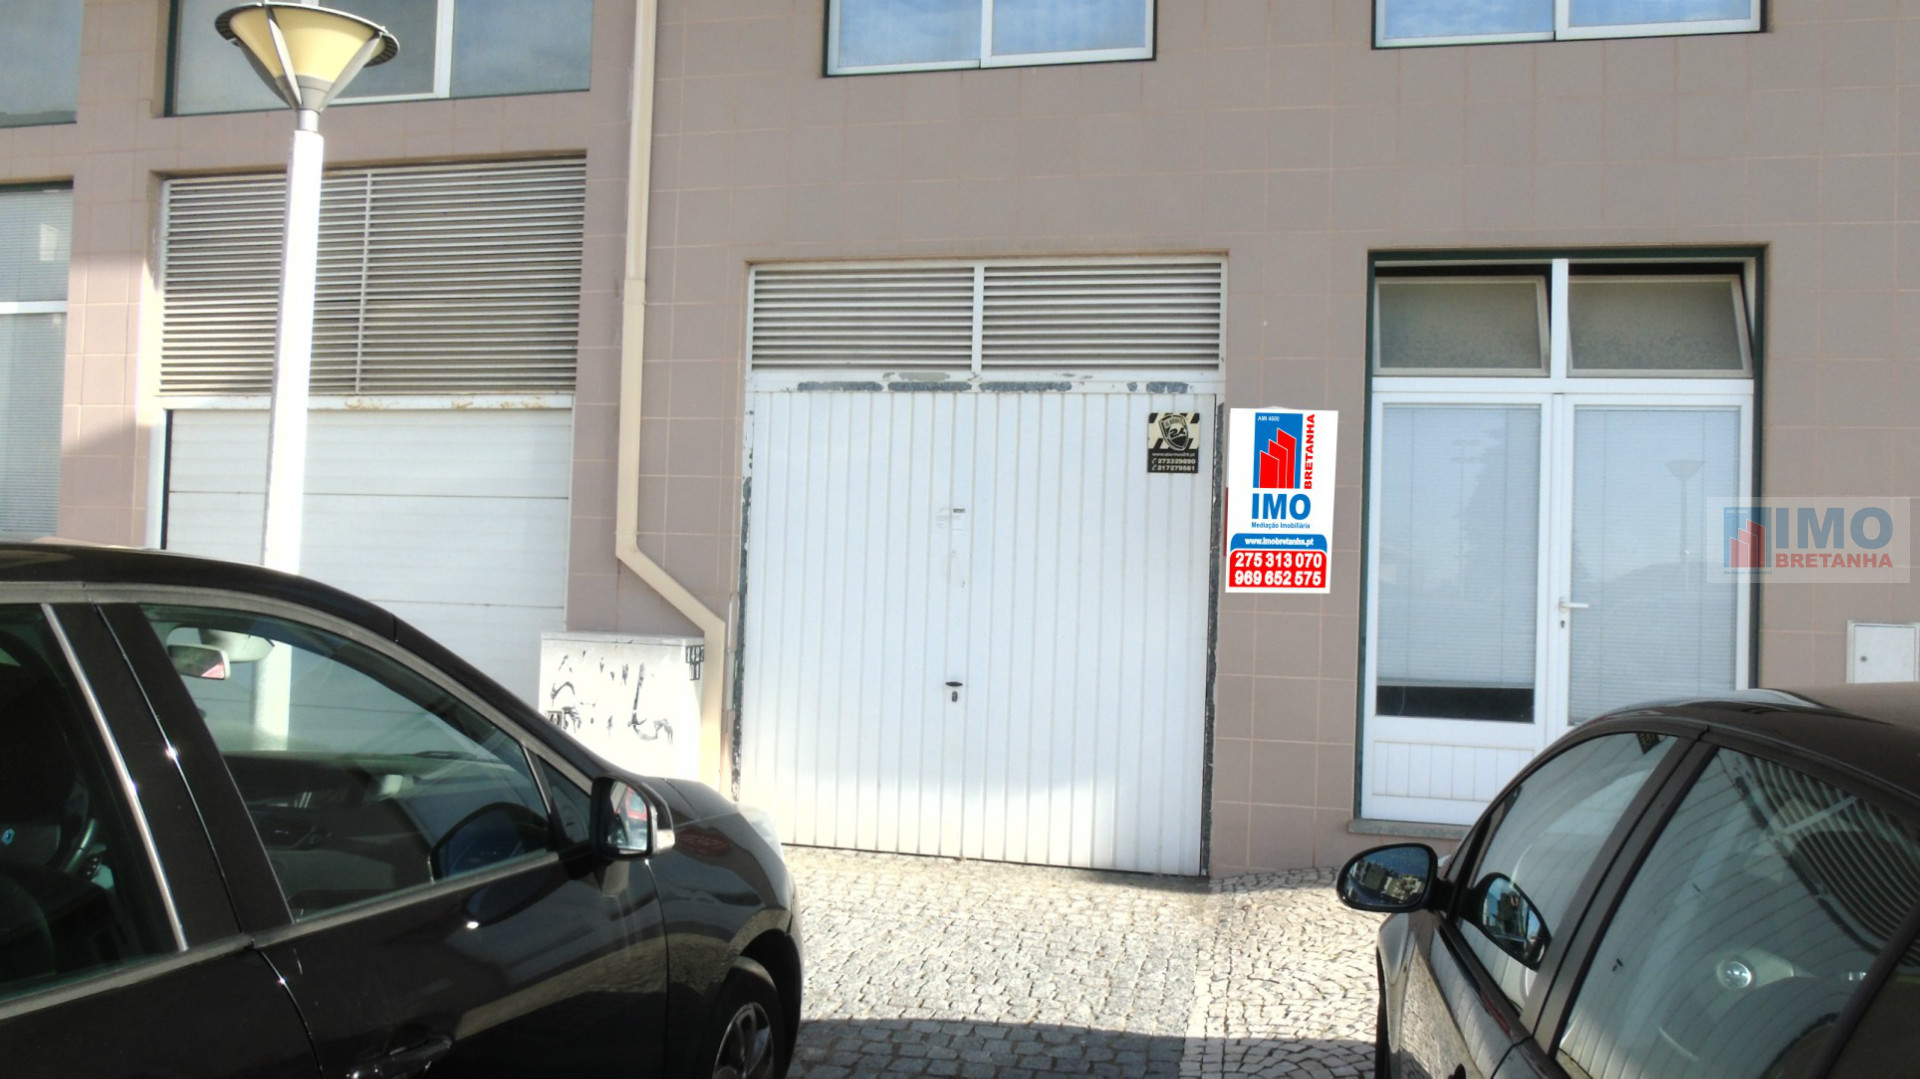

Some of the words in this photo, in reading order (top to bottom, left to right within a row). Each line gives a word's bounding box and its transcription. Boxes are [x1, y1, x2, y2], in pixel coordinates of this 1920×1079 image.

[1304, 414, 1315, 489] BRETANHA
[1251, 493, 1311, 520] IMO
[1251, 521, 1279, 530] Mediação
[1245, 537, 1314, 547] www.imobretanha.pt
[1235, 552, 1263, 567] 275
[1265, 552, 1292, 567] 313
[1295, 553, 1322, 568] 070
[1234, 570, 1262, 585] 969
[1264, 570, 1292, 585] 652
[1294, 571, 1322, 586] 575
